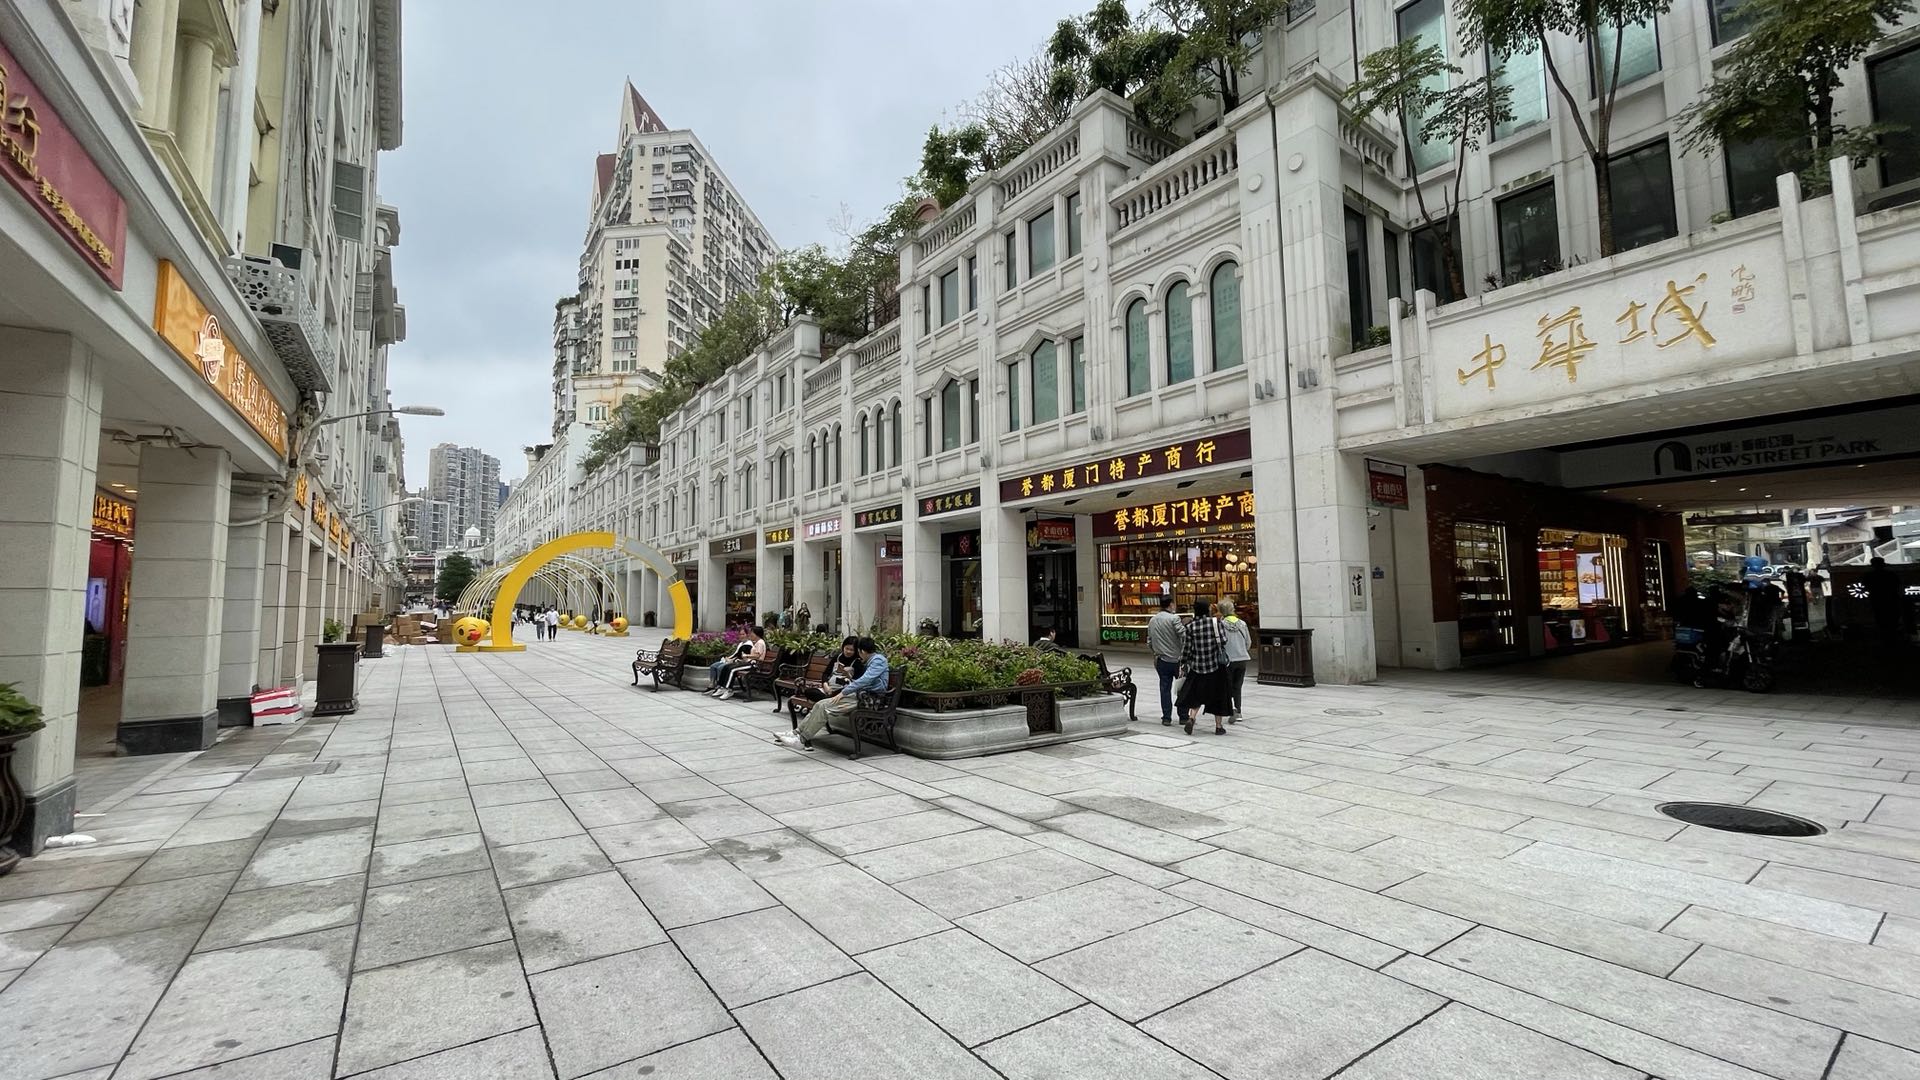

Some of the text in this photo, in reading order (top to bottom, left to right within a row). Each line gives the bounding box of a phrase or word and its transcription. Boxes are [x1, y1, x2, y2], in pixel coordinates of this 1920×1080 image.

[1020, 440, 1216, 497] 誉都厦门特产商行
[1696, 438, 1881, 471] NEWSTREET PARK
